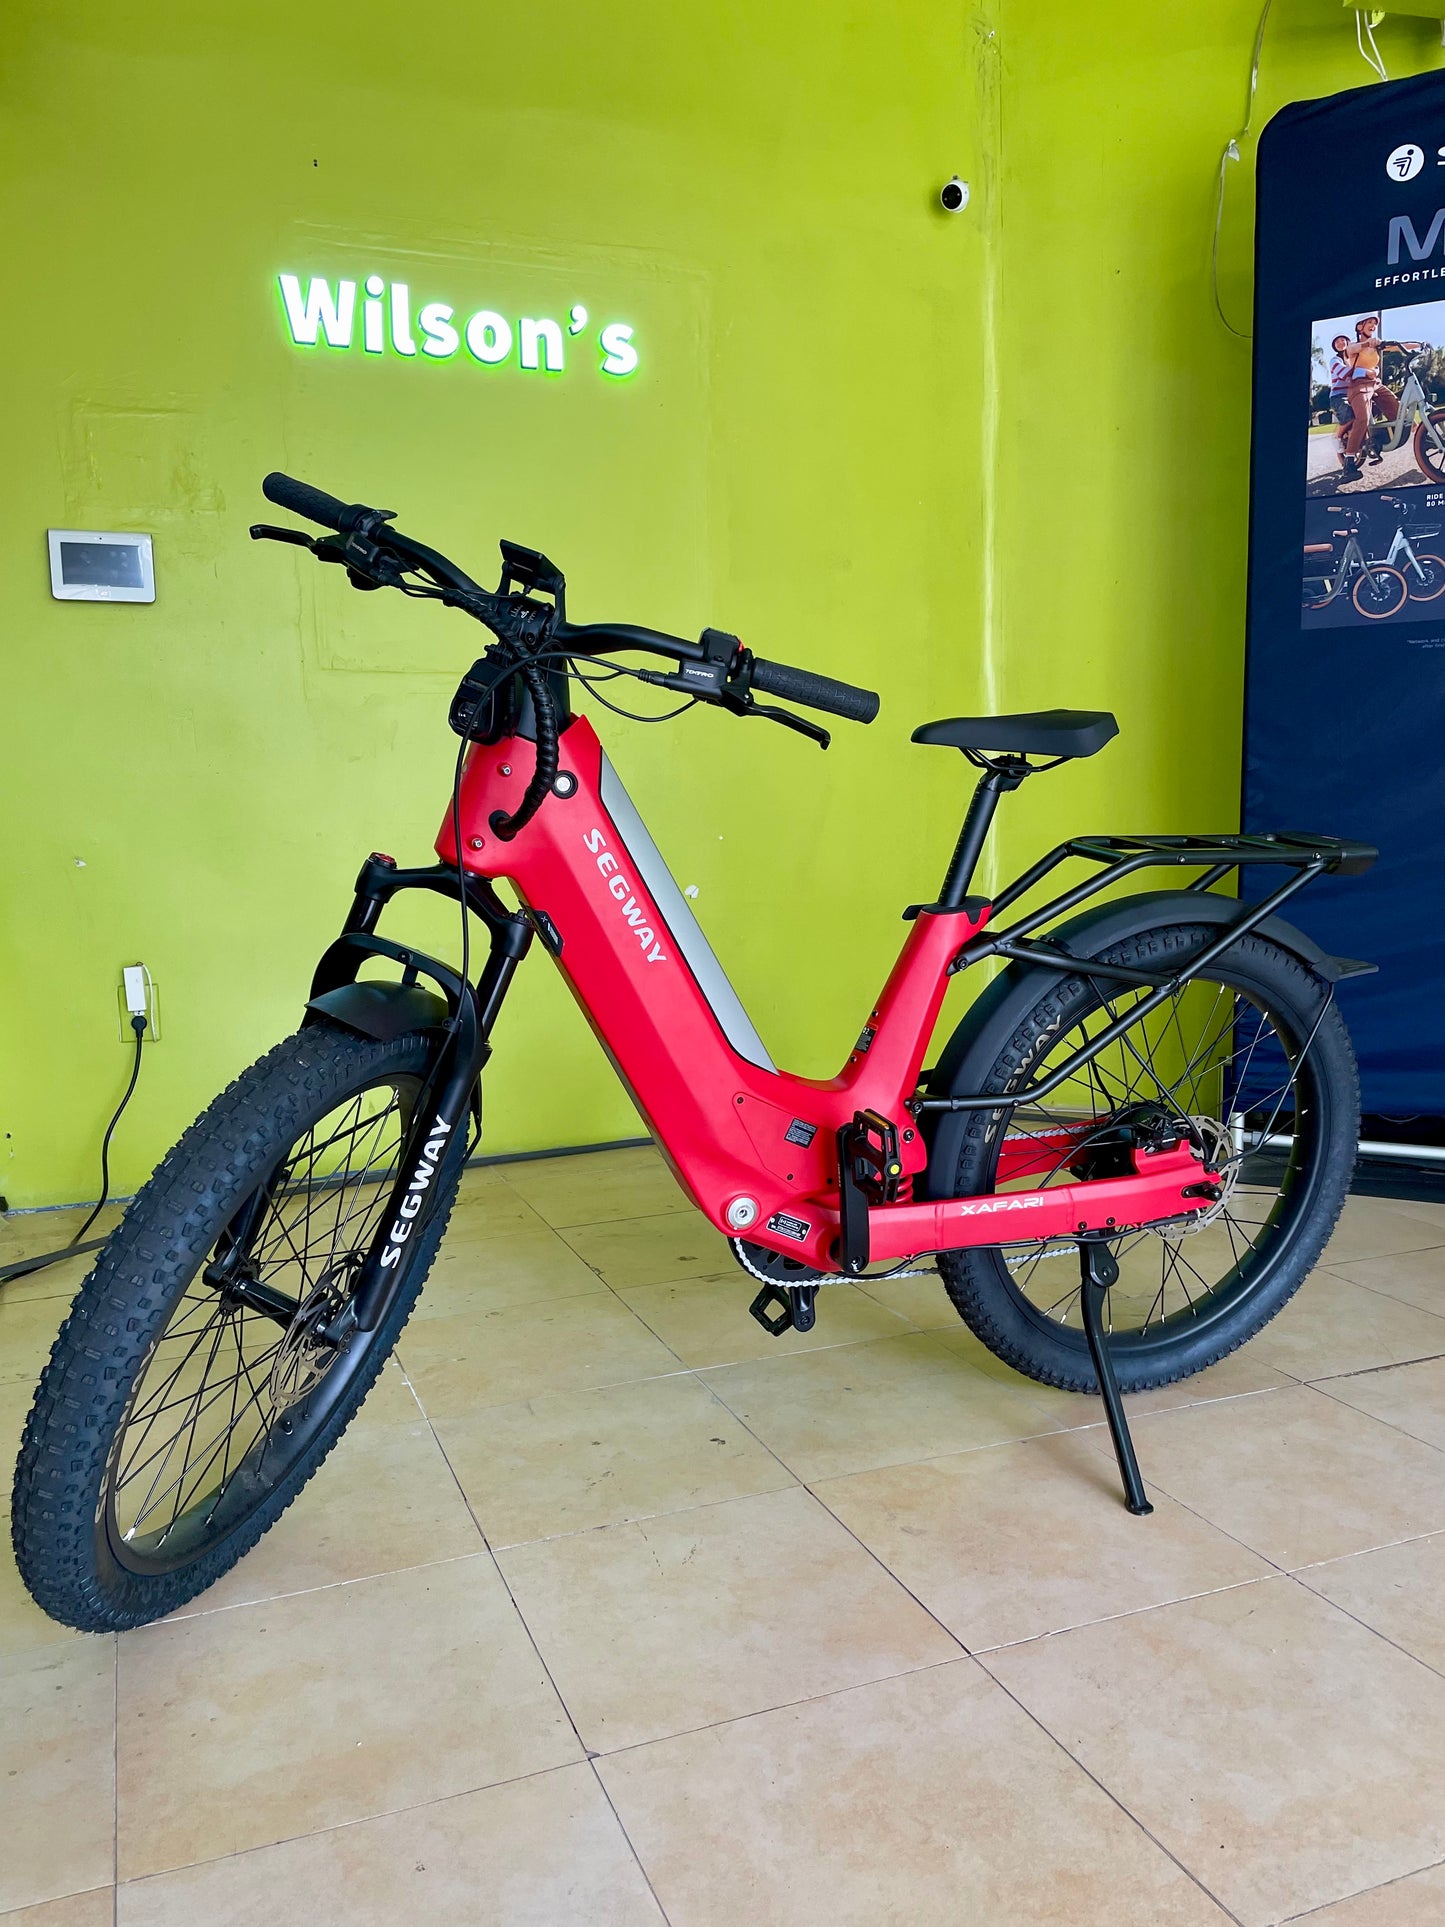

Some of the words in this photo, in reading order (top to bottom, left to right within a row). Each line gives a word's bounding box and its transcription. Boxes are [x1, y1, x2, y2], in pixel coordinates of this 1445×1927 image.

[279, 273, 640, 376] Wilson’s
[1375, 266, 1445, 288] EFFORTLE
[1426, 493, 1444, 501] RIDE
[582, 828, 667, 963] SEGWAY
[984, 1014, 1061, 1144] SEGWAY
[380, 1114, 451, 1269] SEGWAY
[960, 1196, 1044, 1216] XAFARI
